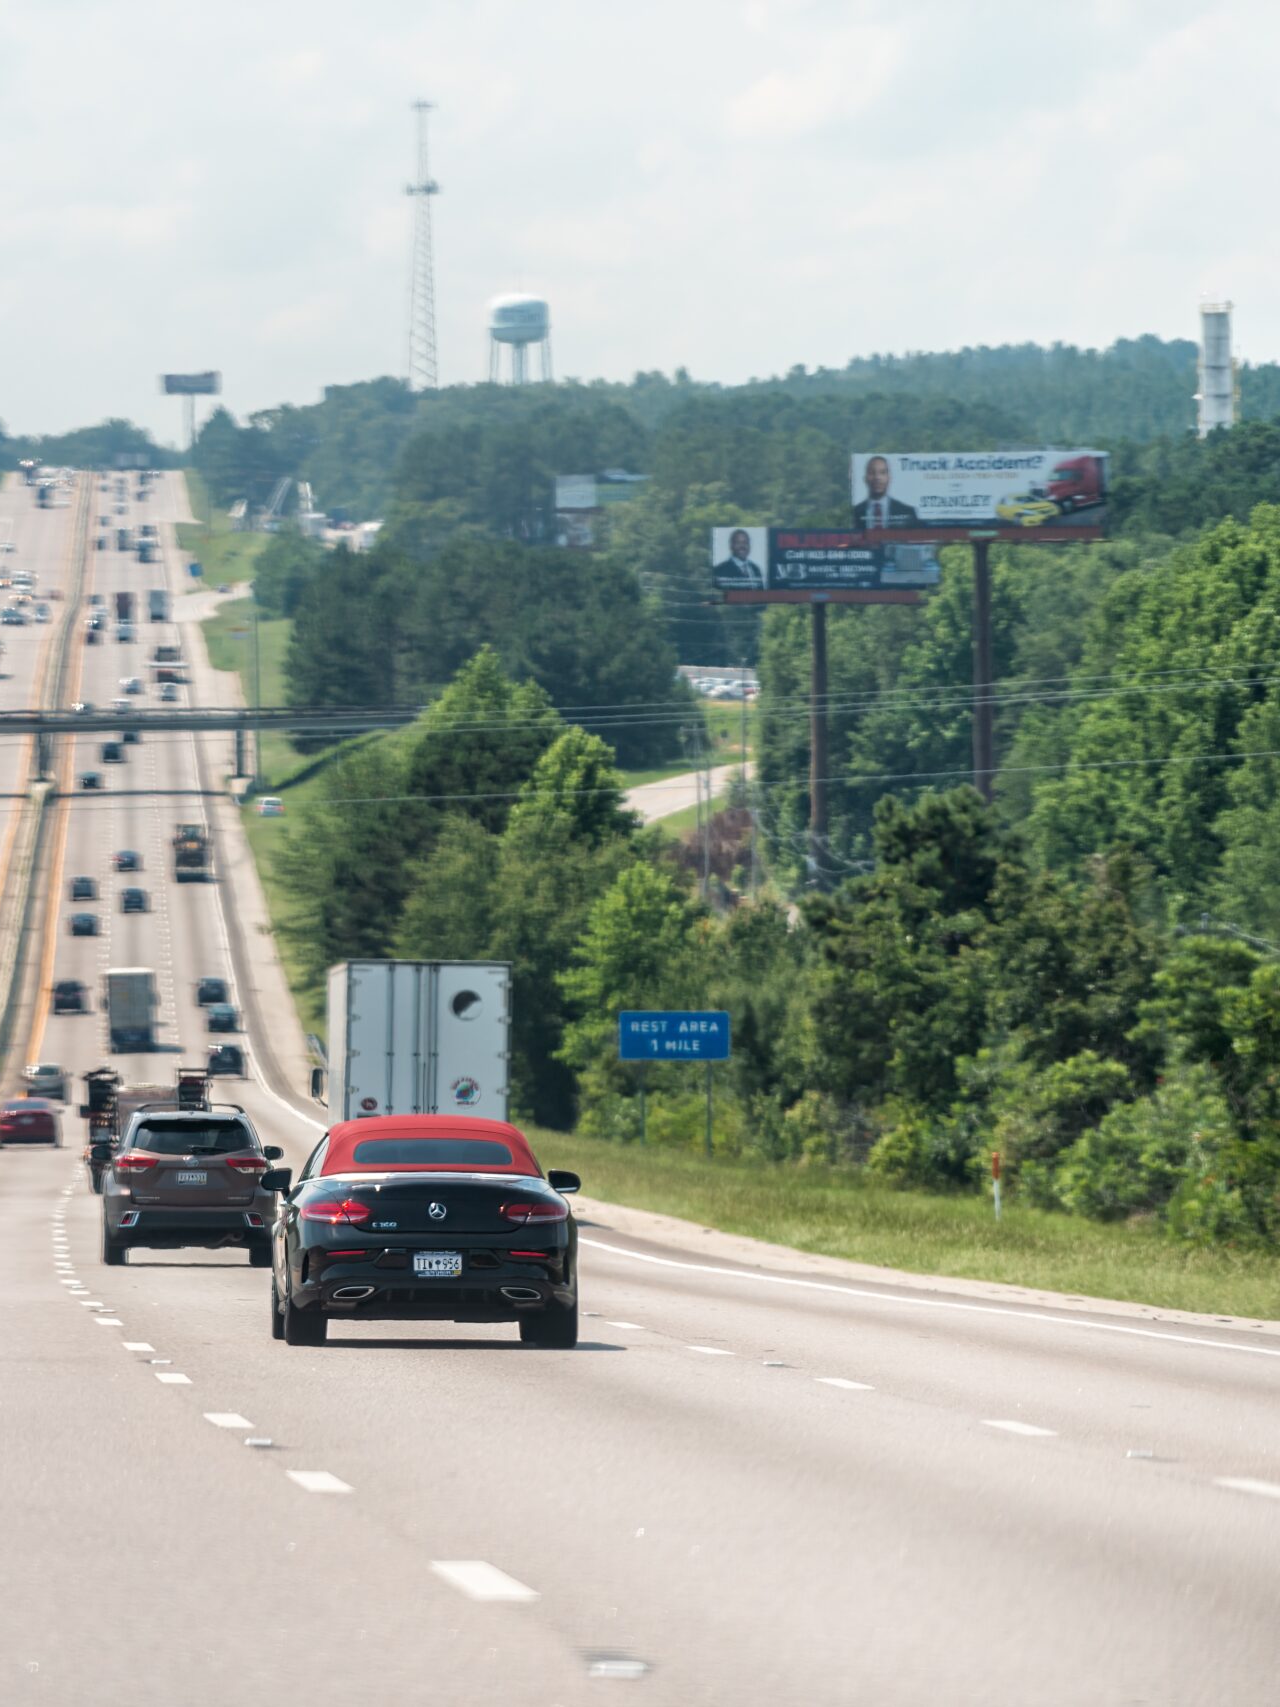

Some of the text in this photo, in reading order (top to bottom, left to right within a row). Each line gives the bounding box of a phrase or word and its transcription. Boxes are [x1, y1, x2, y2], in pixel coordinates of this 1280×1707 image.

[899, 455, 1044, 471] Truck Accident?
[920, 495, 993, 508] STANLEY
[631, 1021, 719, 1033] REST AREA
[651, 1039, 700, 1052] 1 MILE
